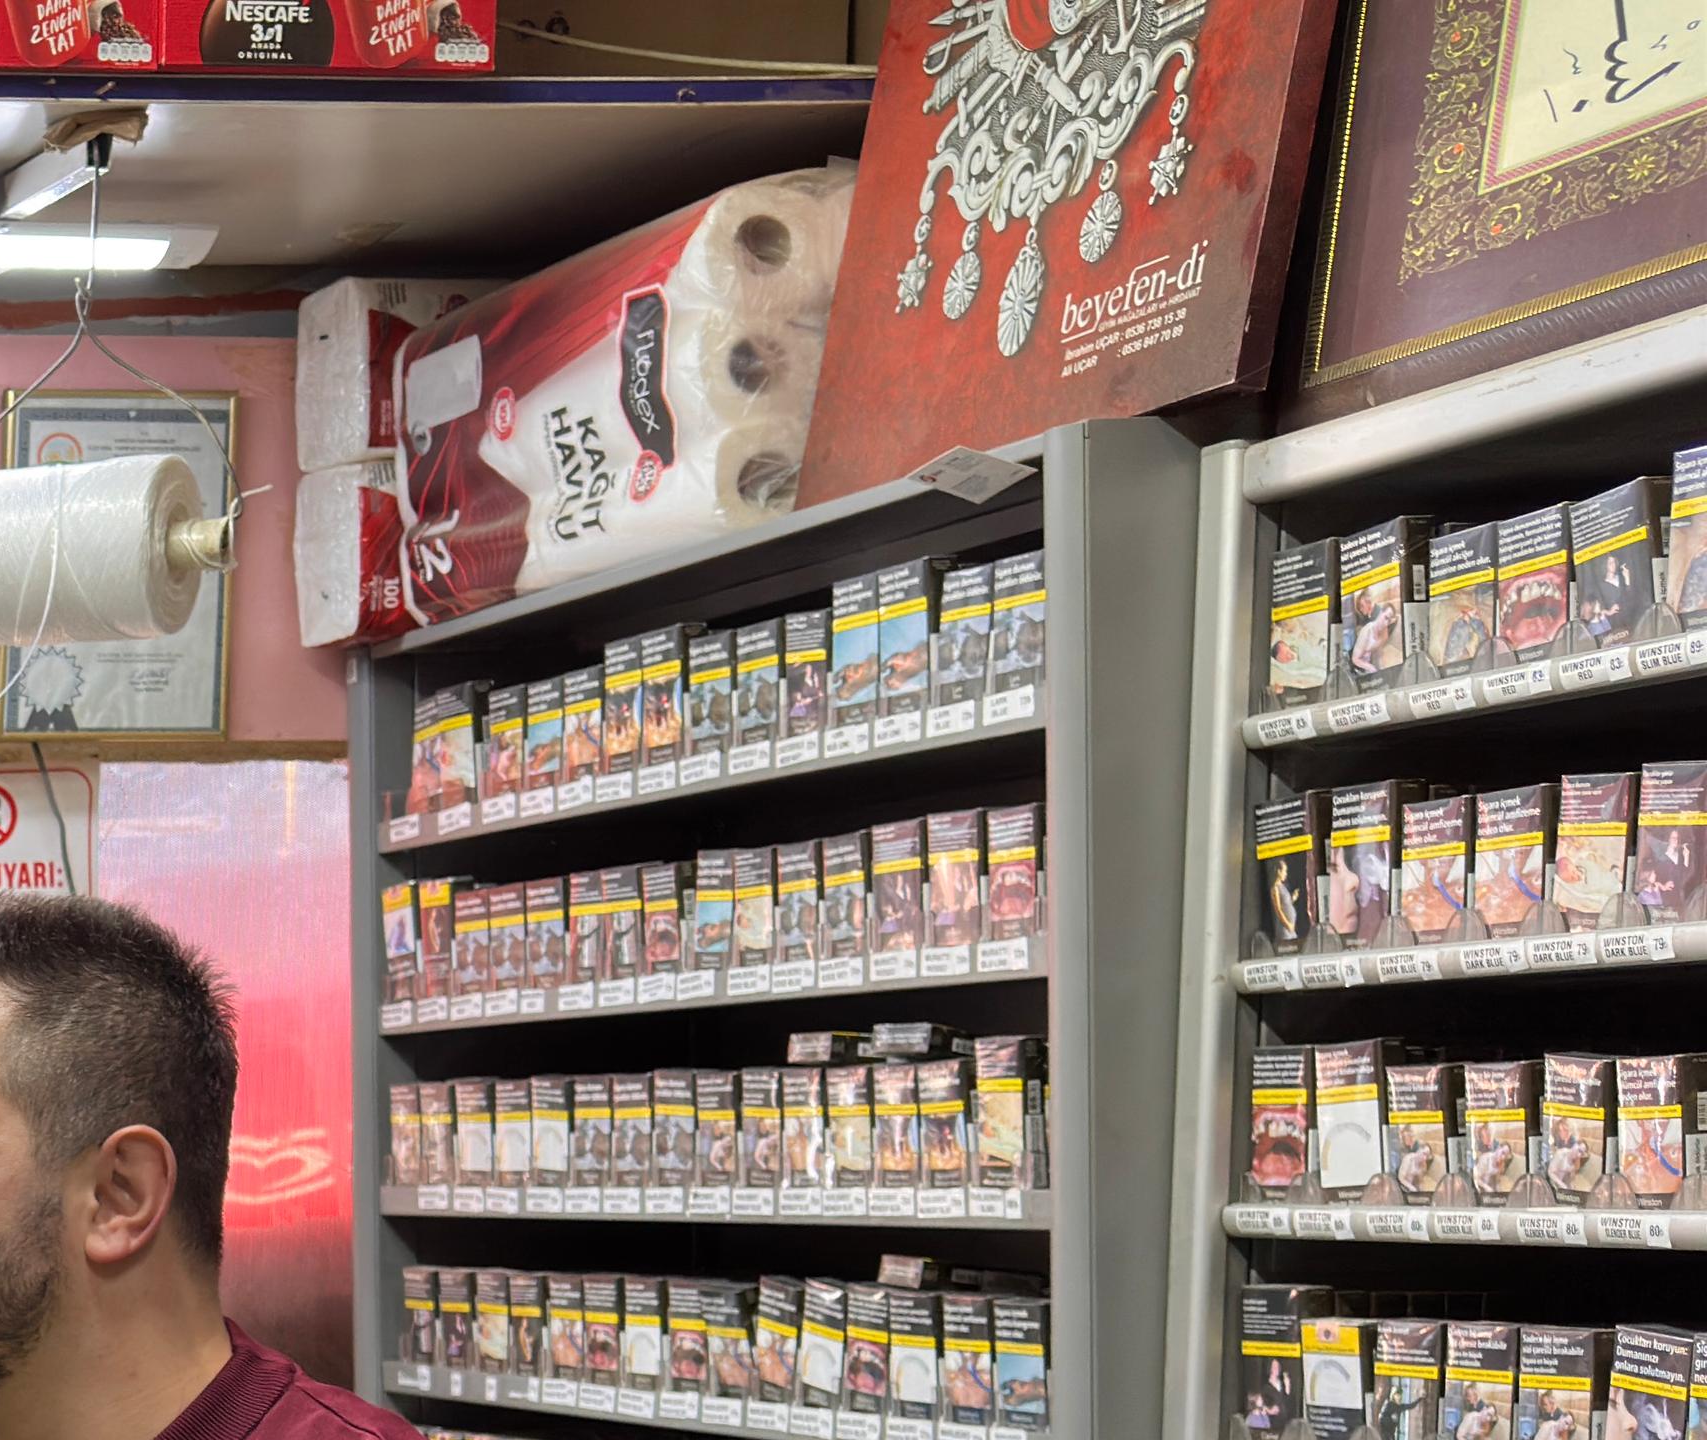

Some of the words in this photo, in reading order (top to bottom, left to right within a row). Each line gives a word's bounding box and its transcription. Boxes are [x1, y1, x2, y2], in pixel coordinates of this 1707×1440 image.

[48, 33, 77, 56] TAT
[387, 28, 417, 57] TAT
[237, 51, 294, 61] ORIGINAL
[550, 406, 580, 541] HAVLU
[575, 415, 618, 533] KAĞIT
[1638, 641, 1682, 660] WINSTON
[1561, 656, 1603, 675] WINSTON
[1533, 940, 1573, 952] WINSTON
[1603, 935, 1645, 948] WINSTON
[1519, 1217, 1558, 1229] WINSTON
[1600, 1216, 1641, 1230] WINSTON
